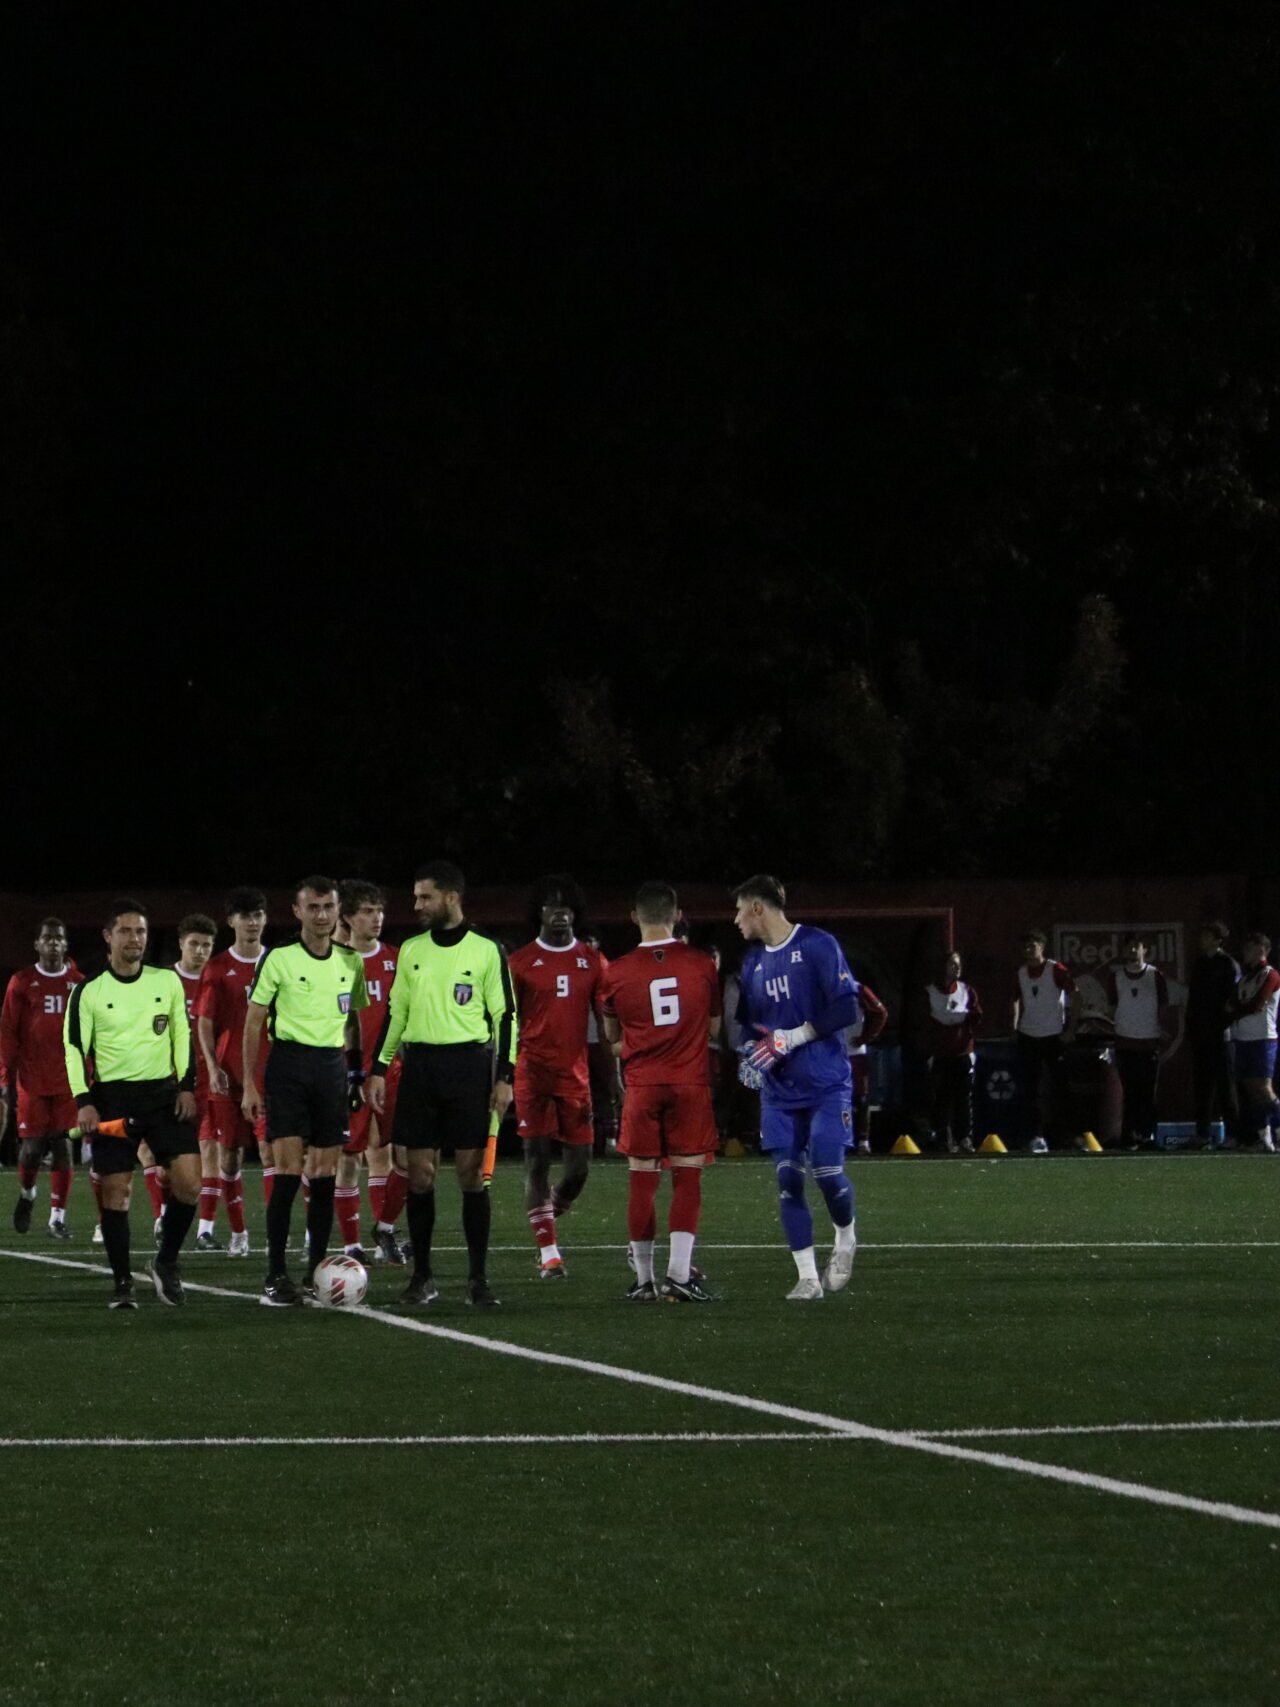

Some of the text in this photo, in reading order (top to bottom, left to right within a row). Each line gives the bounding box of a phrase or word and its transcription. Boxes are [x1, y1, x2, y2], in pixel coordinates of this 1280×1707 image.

[791, 950, 803, 963] R
[1063, 933, 1119, 964] Red
[383, 960, 395, 971] R
[576, 957, 588, 969] R
[556, 974, 569, 998] 9
[765, 974, 790, 1003] 44
[44, 995, 63, 1014] 31
[649, 976, 680, 1026] 6
